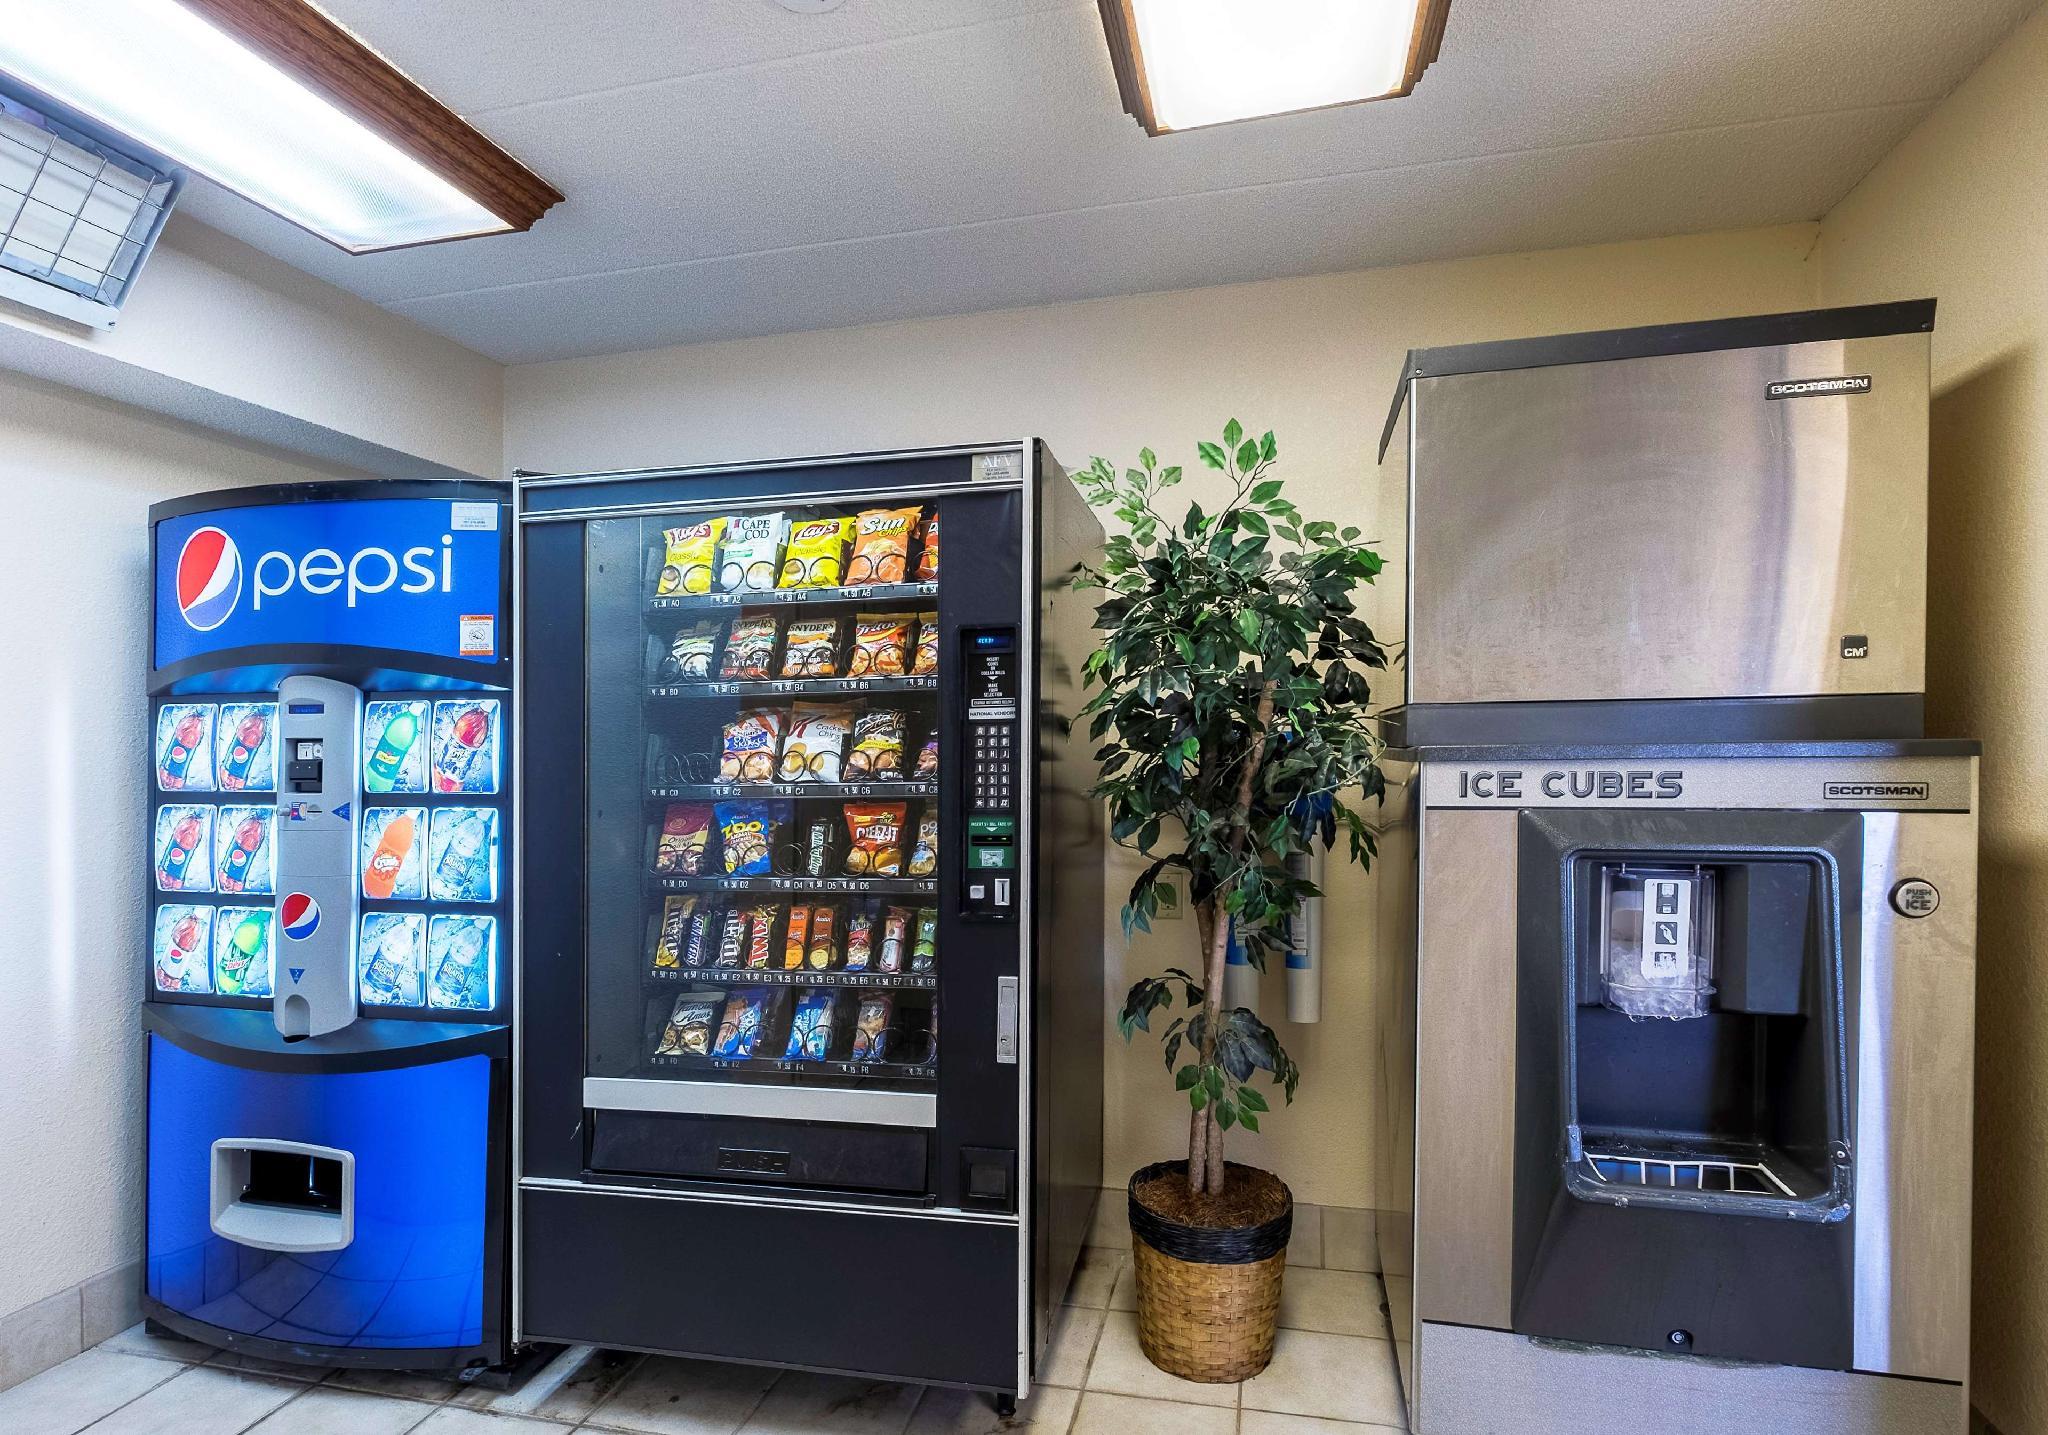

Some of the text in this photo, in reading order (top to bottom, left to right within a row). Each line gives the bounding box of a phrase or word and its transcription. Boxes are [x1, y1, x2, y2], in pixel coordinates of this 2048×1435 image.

[1771, 378, 1868, 395] SCOTSMAN
[742, 519, 770, 530] CAPE
[861, 517, 906, 535] Sun
[744, 530, 769, 540] COD
[879, 526, 907, 537] Chips
[253, 534, 453, 611] pepsi
[797, 592, 806, 600] A4
[861, 589, 871, 597] A6
[794, 683, 804, 691] B4
[860, 681, 869, 689] B6
[730, 686, 740, 694] B2
[1459, 770, 1683, 798] ICE CUBES
[733, 788, 741, 796] C2
[795, 787, 804, 795] C4
[861, 786, 871, 795] C6
[1829, 786, 1924, 795] SCOTSMAN
[827, 881, 837, 889] D5
[860, 881, 869, 889] D6
[1906, 888, 1932, 896] PUSH
[1905, 899, 1931, 910] ICE
[751, 917, 769, 962] TWIX
[673, 1001, 713, 1016] Famous
[677, 1010, 711, 1023] Amos
